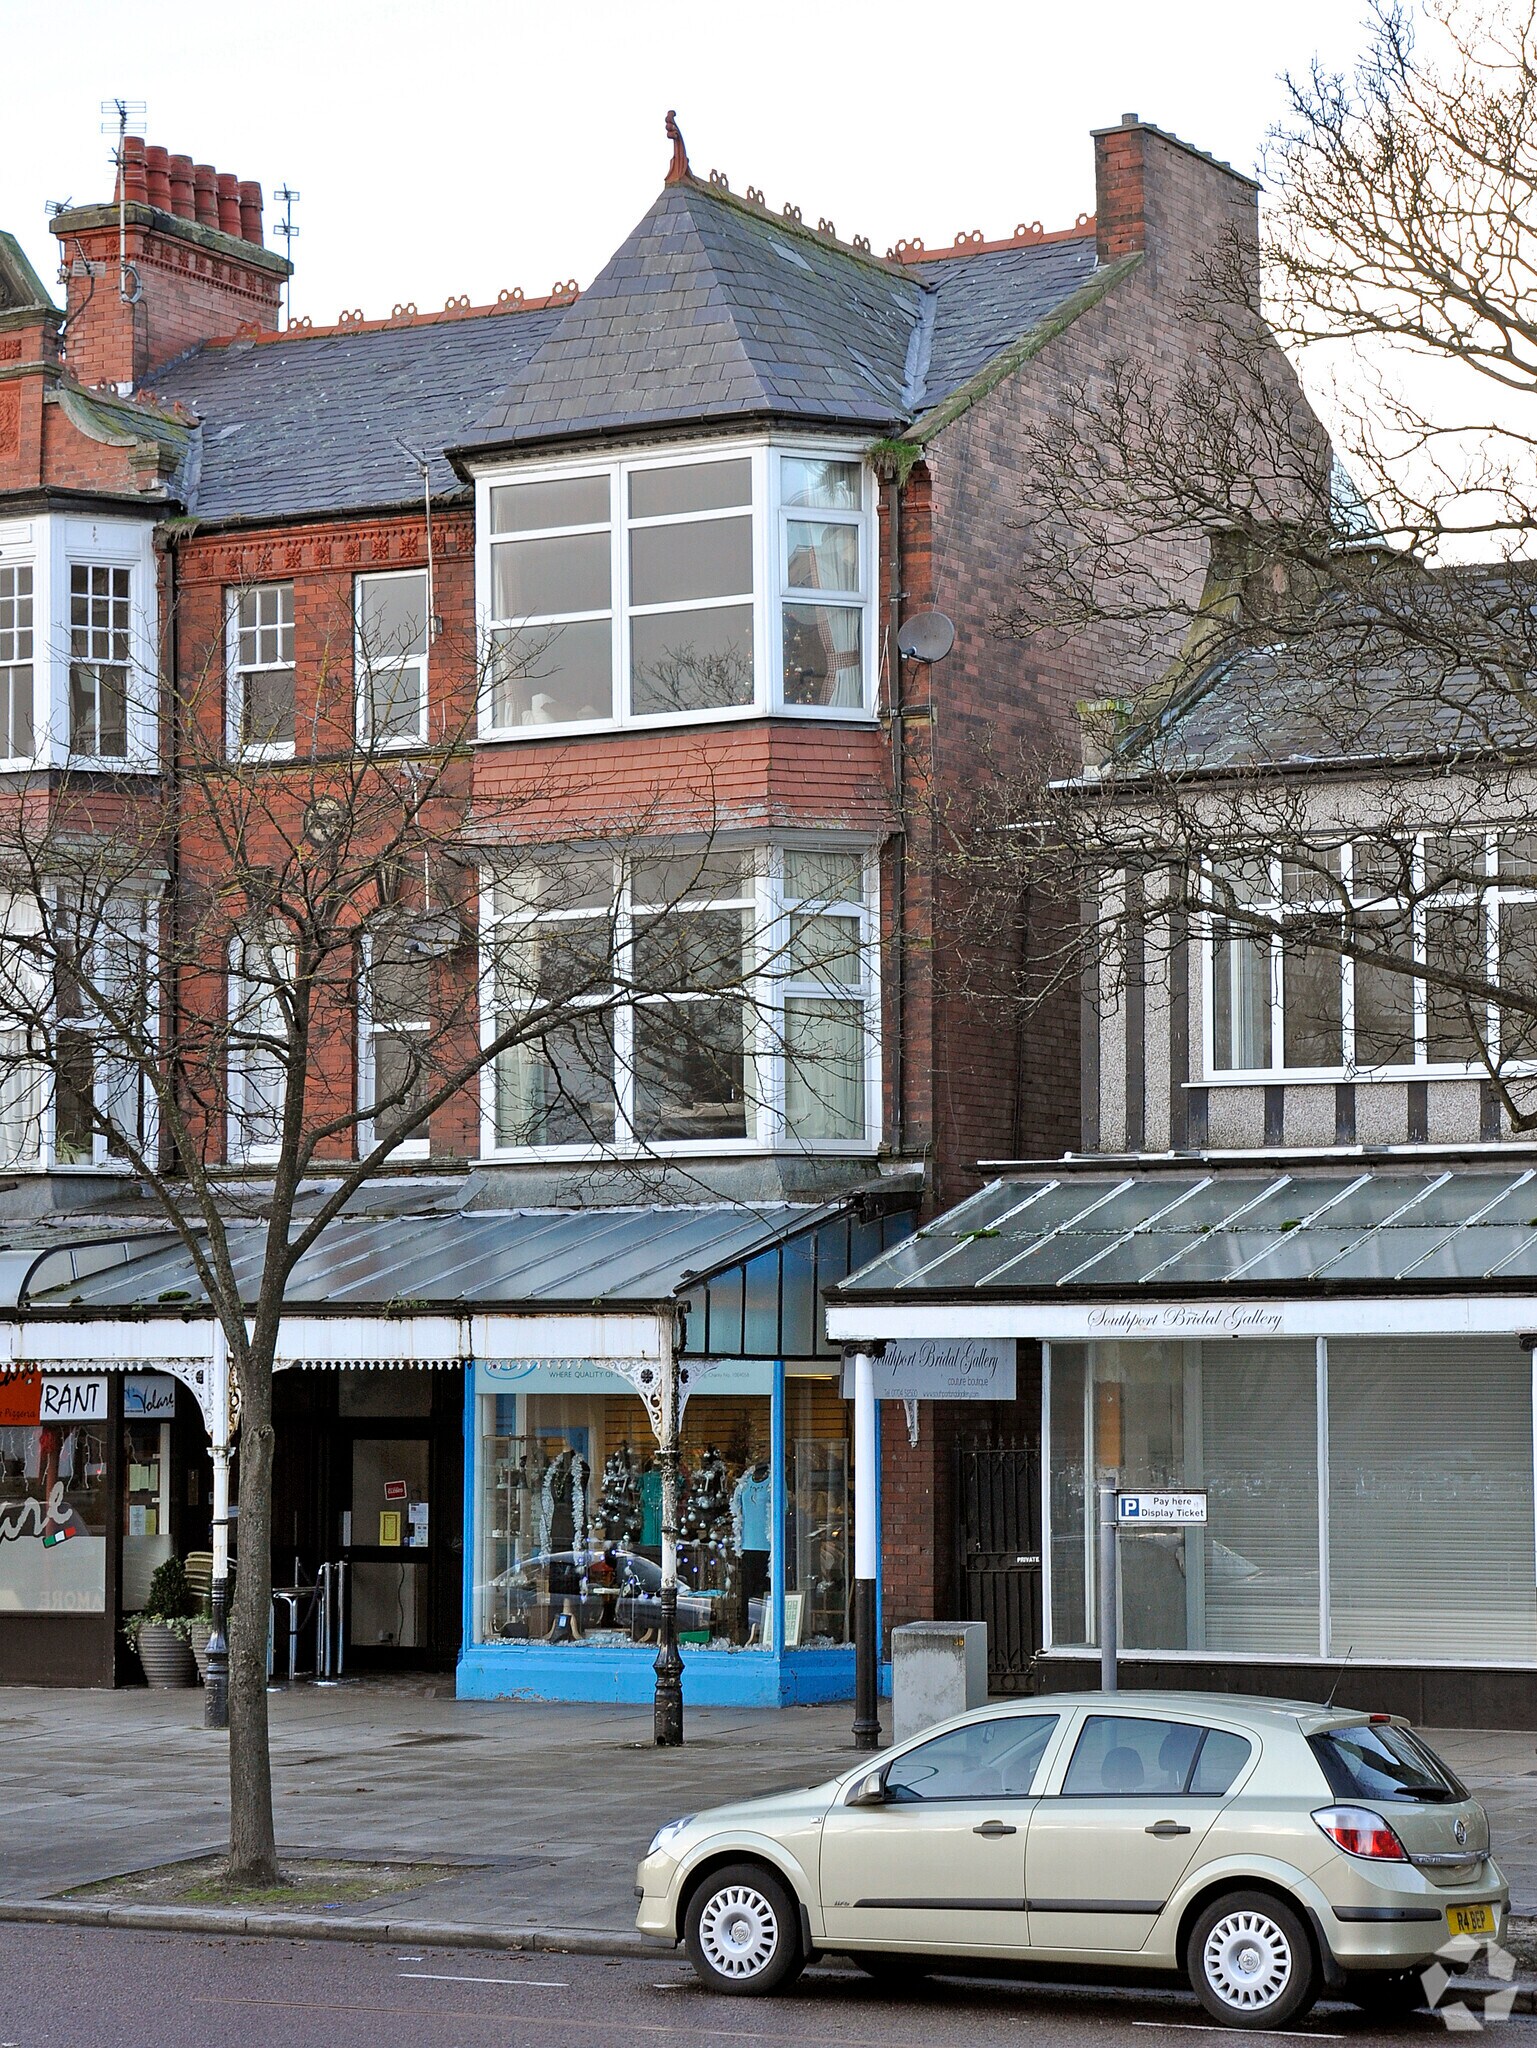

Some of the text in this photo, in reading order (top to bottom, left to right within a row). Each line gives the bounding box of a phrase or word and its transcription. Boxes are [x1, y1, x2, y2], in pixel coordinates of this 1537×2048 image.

[1087, 1304, 1283, 1334] Southport Bridal Gallery
[872, 1340, 999, 1378] outhport Bridal Gallery
[574, 1371, 603, 1379] QUALITY
[41, 1383, 100, 1414] RANT
[5, 1408, 36, 1419] Pizzeria
[1153, 1497, 1192, 1507] Pay here
[1141, 1508, 1204, 1518] Display Ticket
[1456, 1911, 1470, 1931] R4
